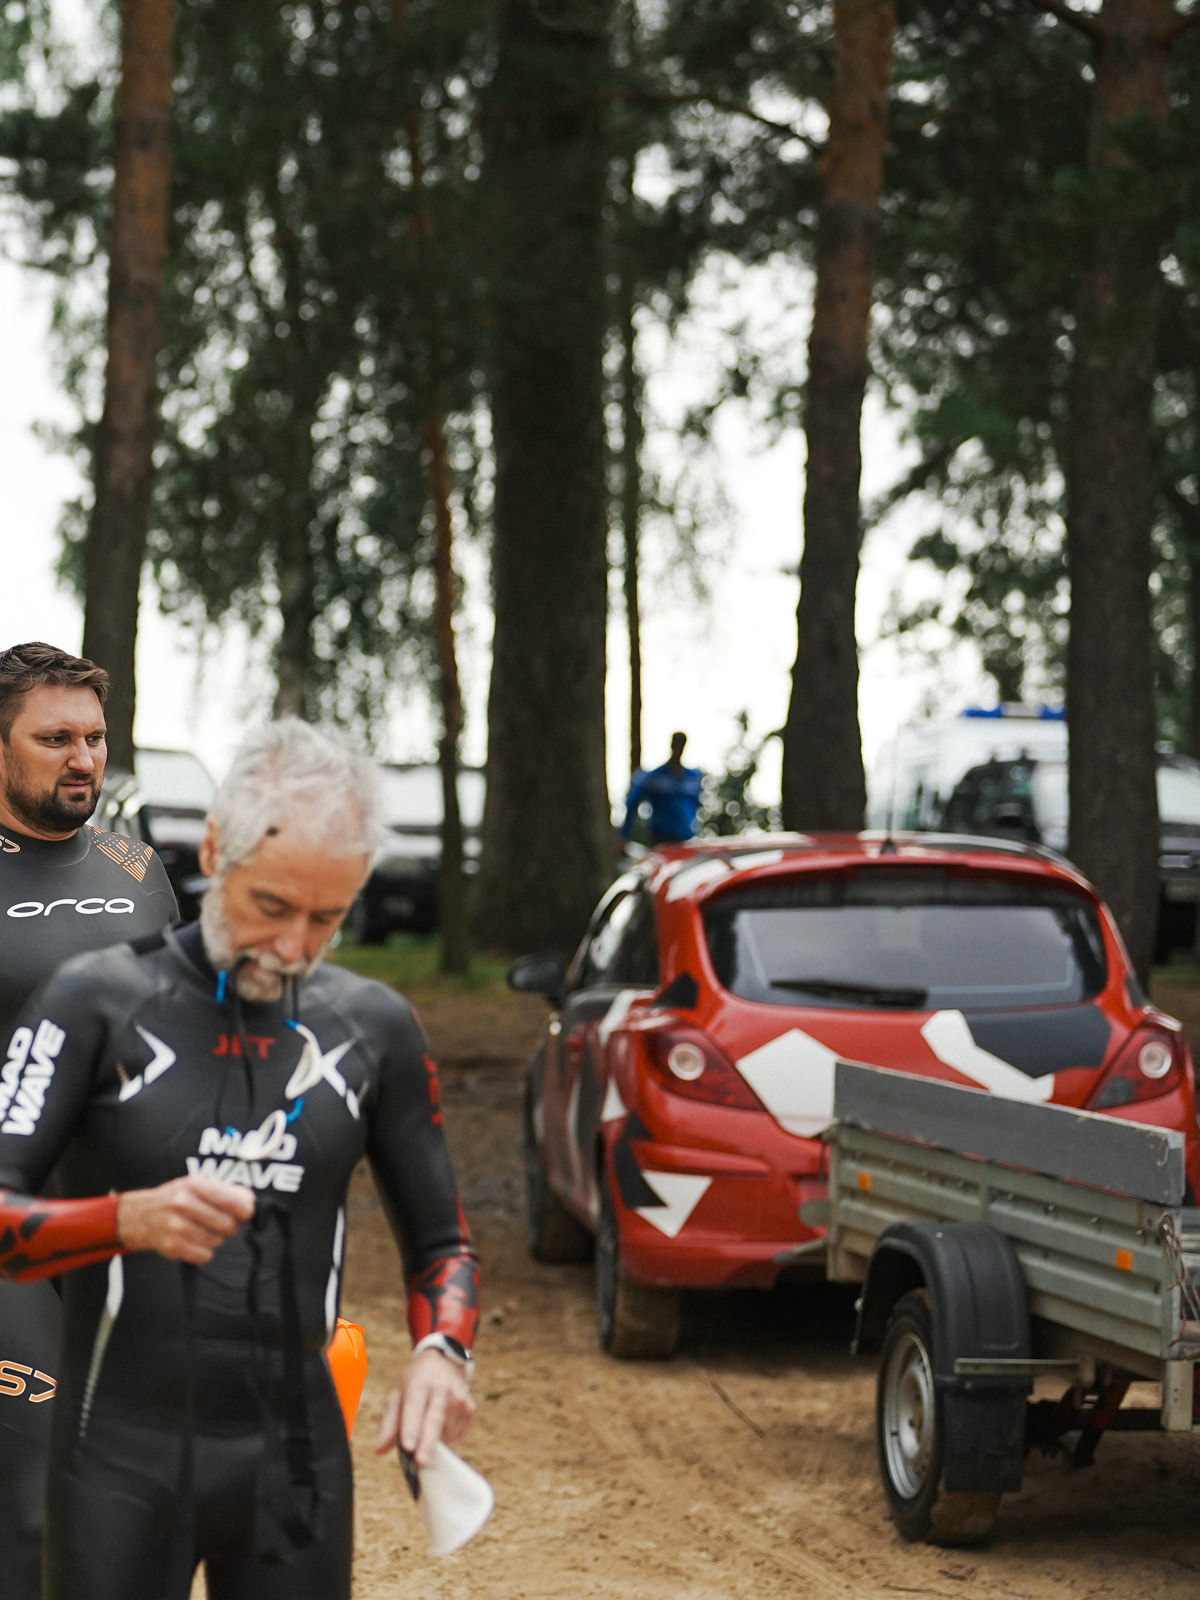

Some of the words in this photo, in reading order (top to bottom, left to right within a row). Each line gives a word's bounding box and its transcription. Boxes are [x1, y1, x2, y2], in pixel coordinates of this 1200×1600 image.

[7, 898, 135, 918] orca
[1, 1018, 66, 1135] WAVE
[186, 1156, 305, 1193] WAVE
